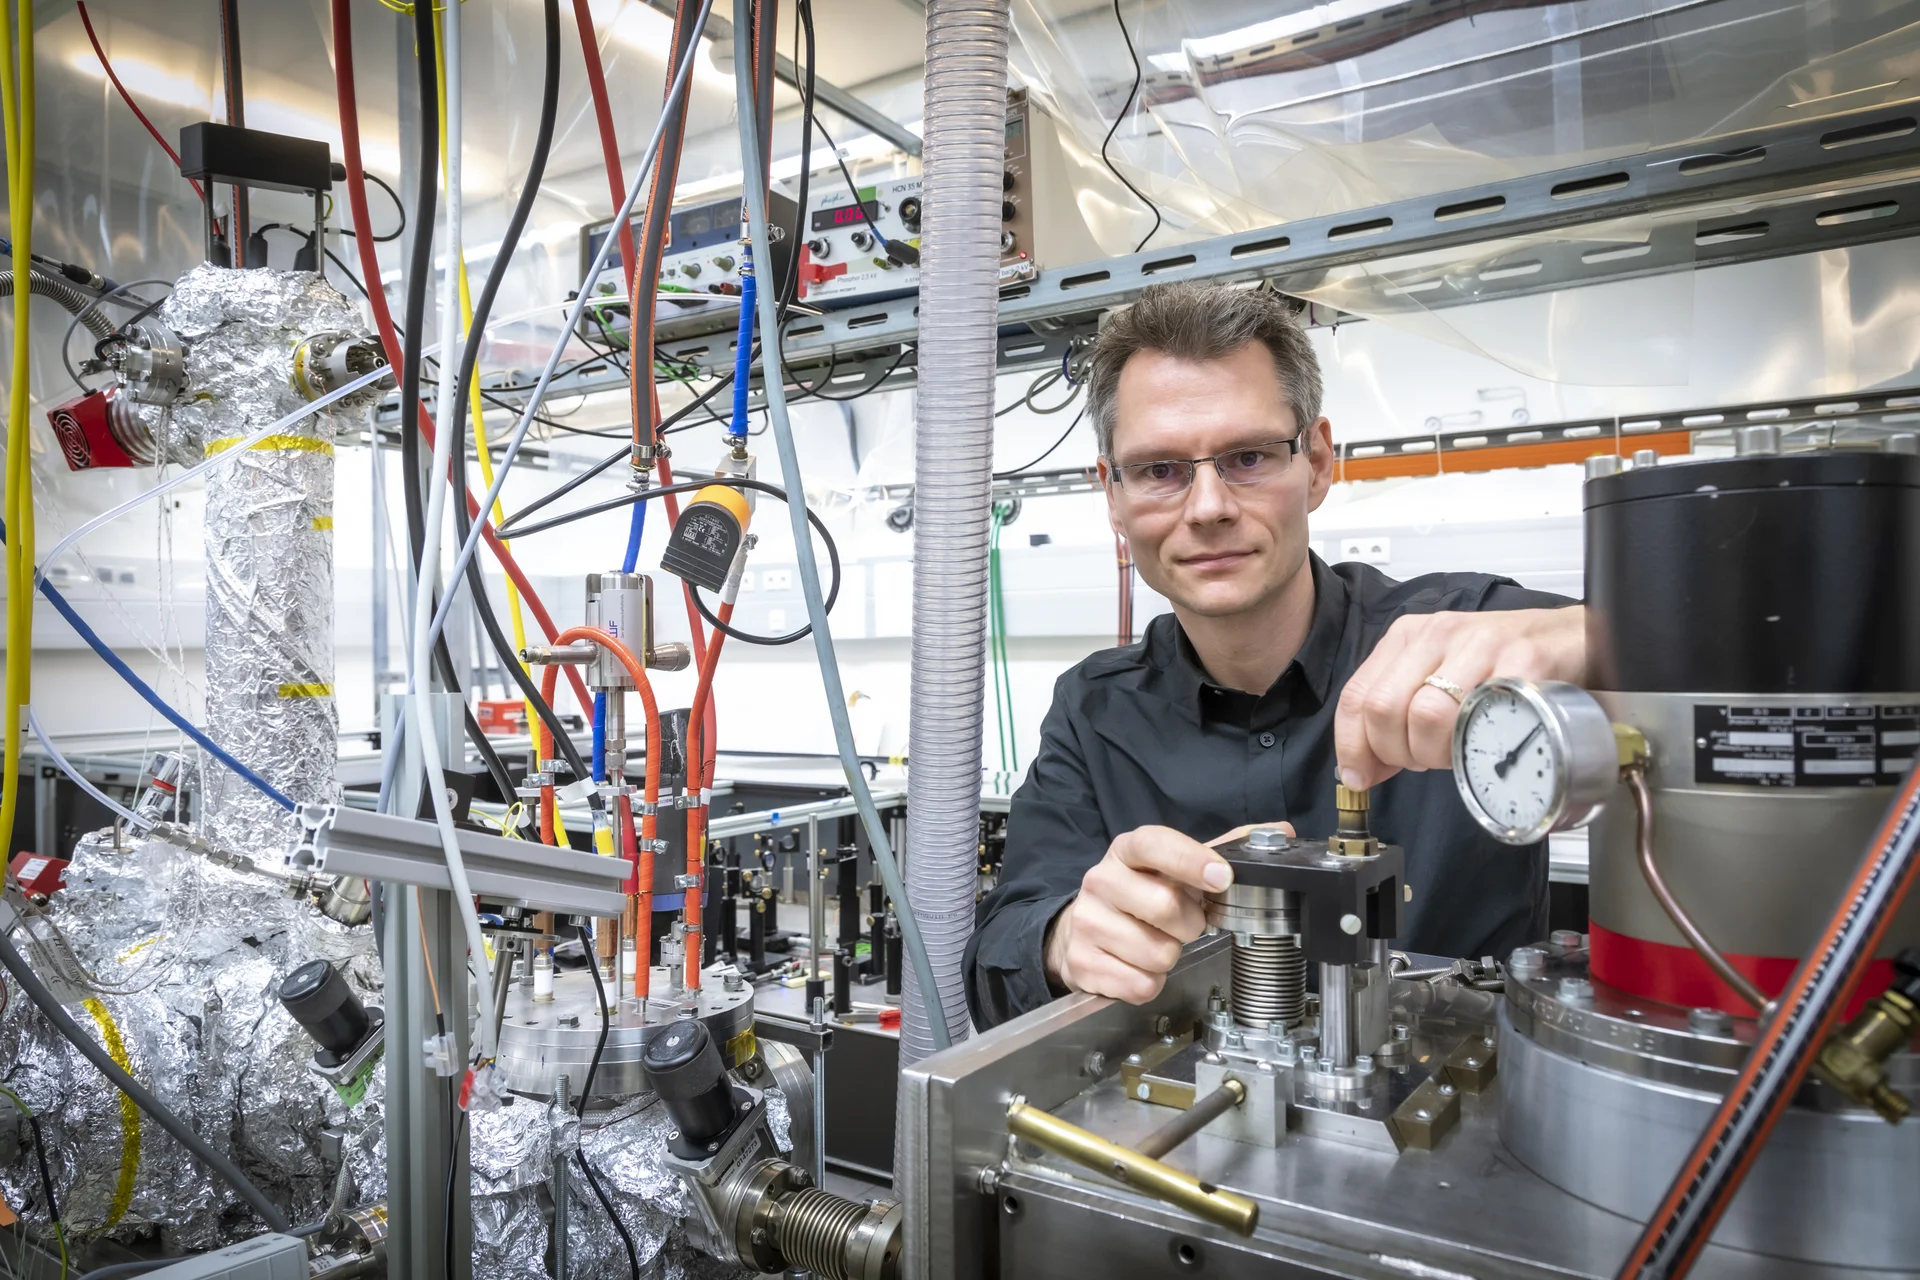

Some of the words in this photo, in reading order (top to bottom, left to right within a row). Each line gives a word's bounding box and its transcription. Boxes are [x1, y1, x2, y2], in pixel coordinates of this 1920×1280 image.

[892, 184, 906, 193] HCN
[837, 275, 860, 284] Phosphor
[609, 620, 618, 638] WF
